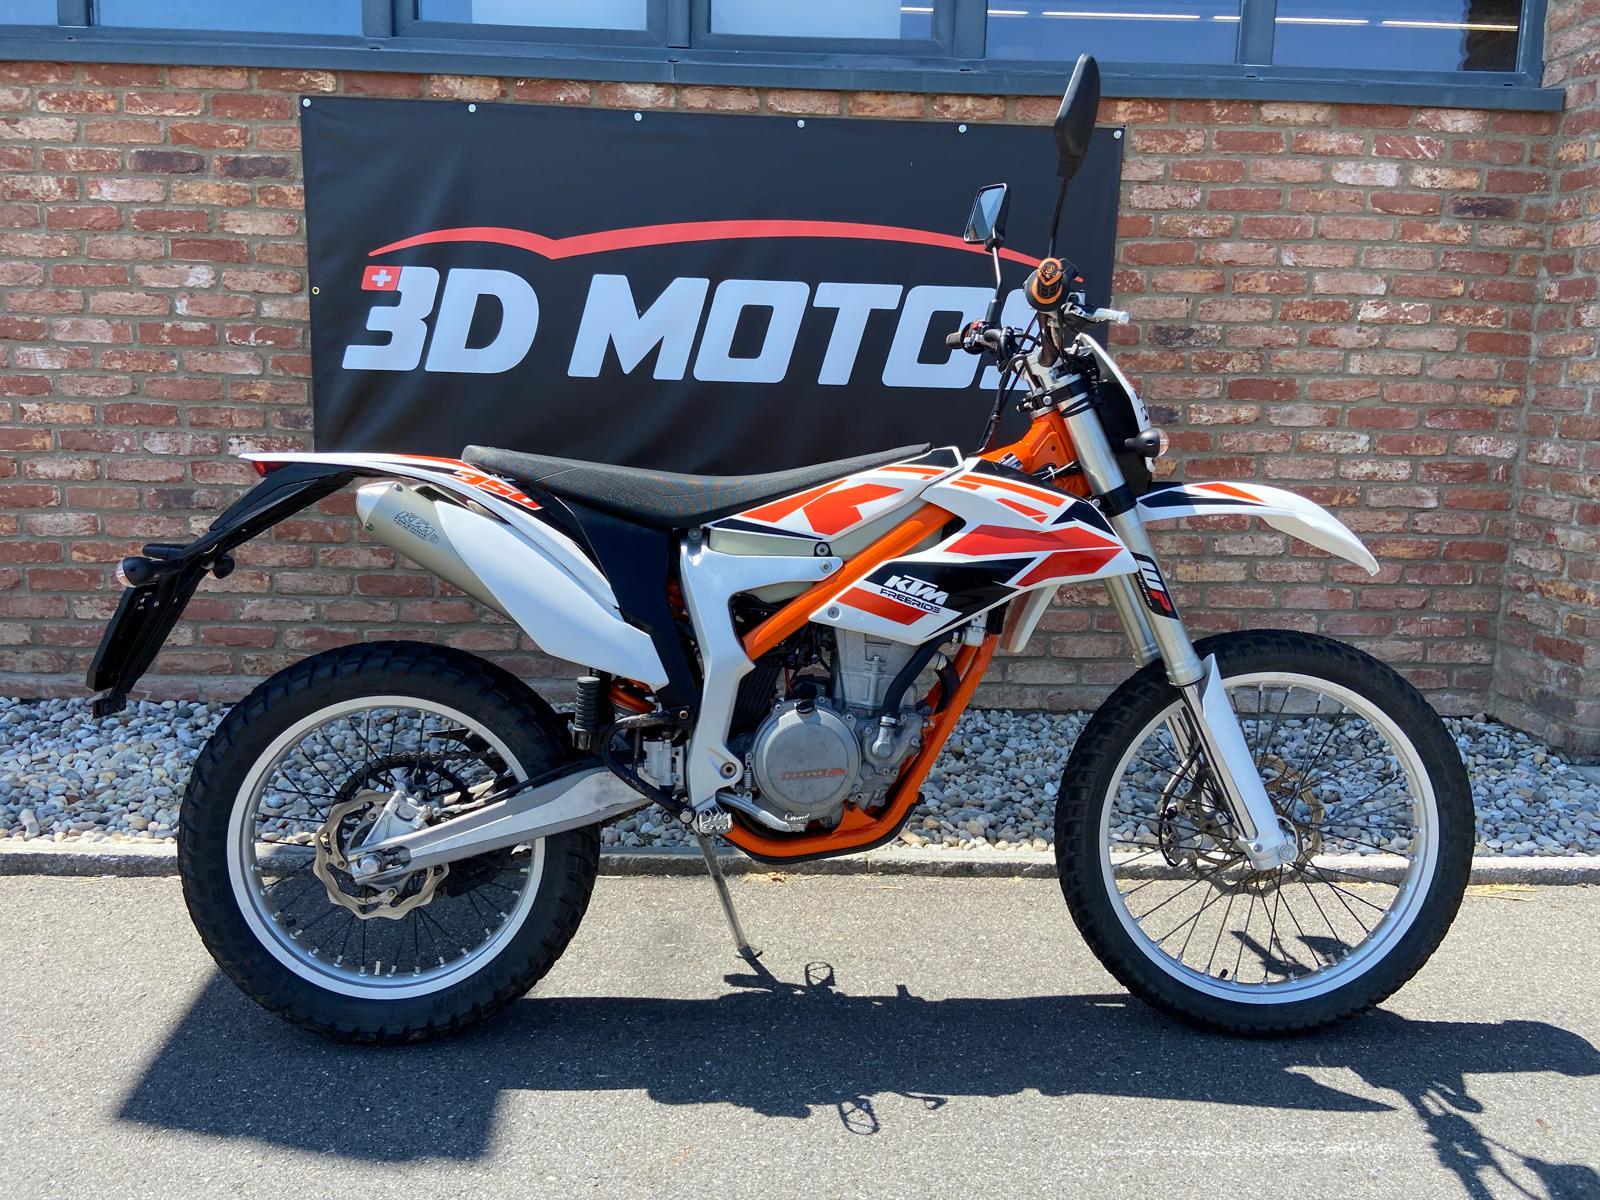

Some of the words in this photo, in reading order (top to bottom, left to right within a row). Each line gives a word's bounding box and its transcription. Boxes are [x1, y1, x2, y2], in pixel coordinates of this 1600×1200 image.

[341, 265, 540, 374] 3D
[450, 469, 543, 511] 350
[395, 509, 436, 537] KTM
[879, 588, 942, 614] FREERIDE
[883, 574, 950, 606] KTM
